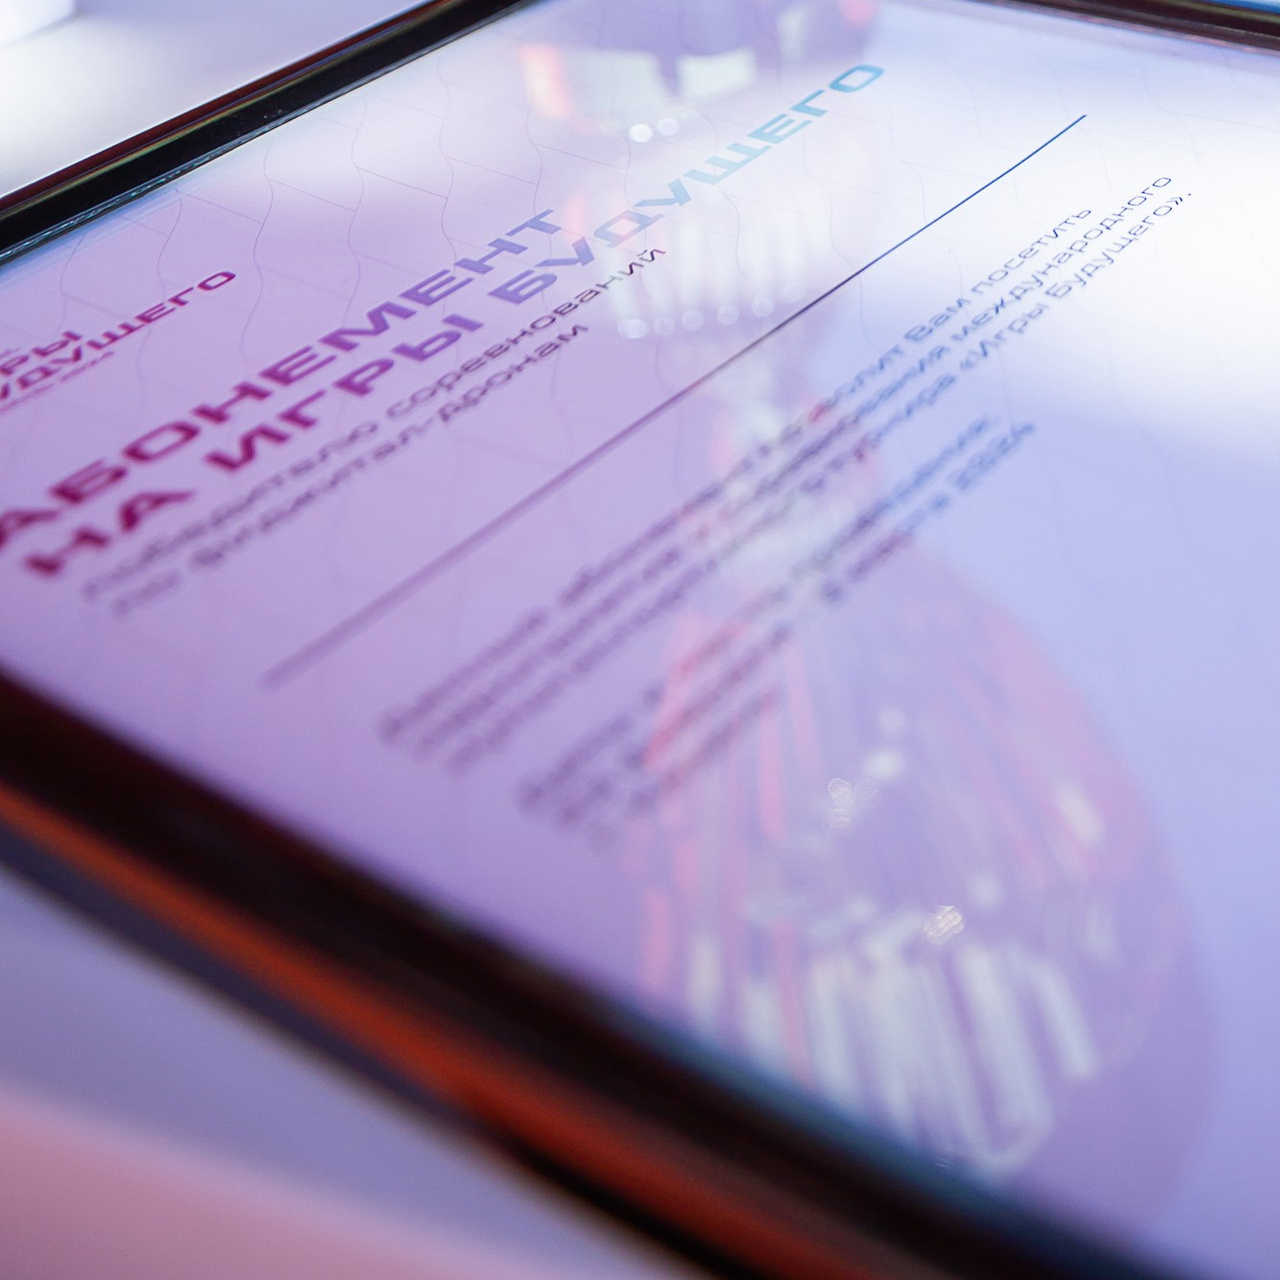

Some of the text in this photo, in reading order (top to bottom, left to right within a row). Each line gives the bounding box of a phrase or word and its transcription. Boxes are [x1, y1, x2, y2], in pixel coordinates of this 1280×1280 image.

[24, 489, 195, 578] НА
[203, 312, 485, 473] ИГРЫ
[487, 63, 886, 306] БУДУЩЕГО
[949, 176, 1172, 342] международного
[970, 208, 1092, 295] посетить
[1044, 191, 1192, 300] Будущего».
[0, 208, 563, 554] АБОНЕМЕНТ
[385, 246, 667, 420] соревнований
